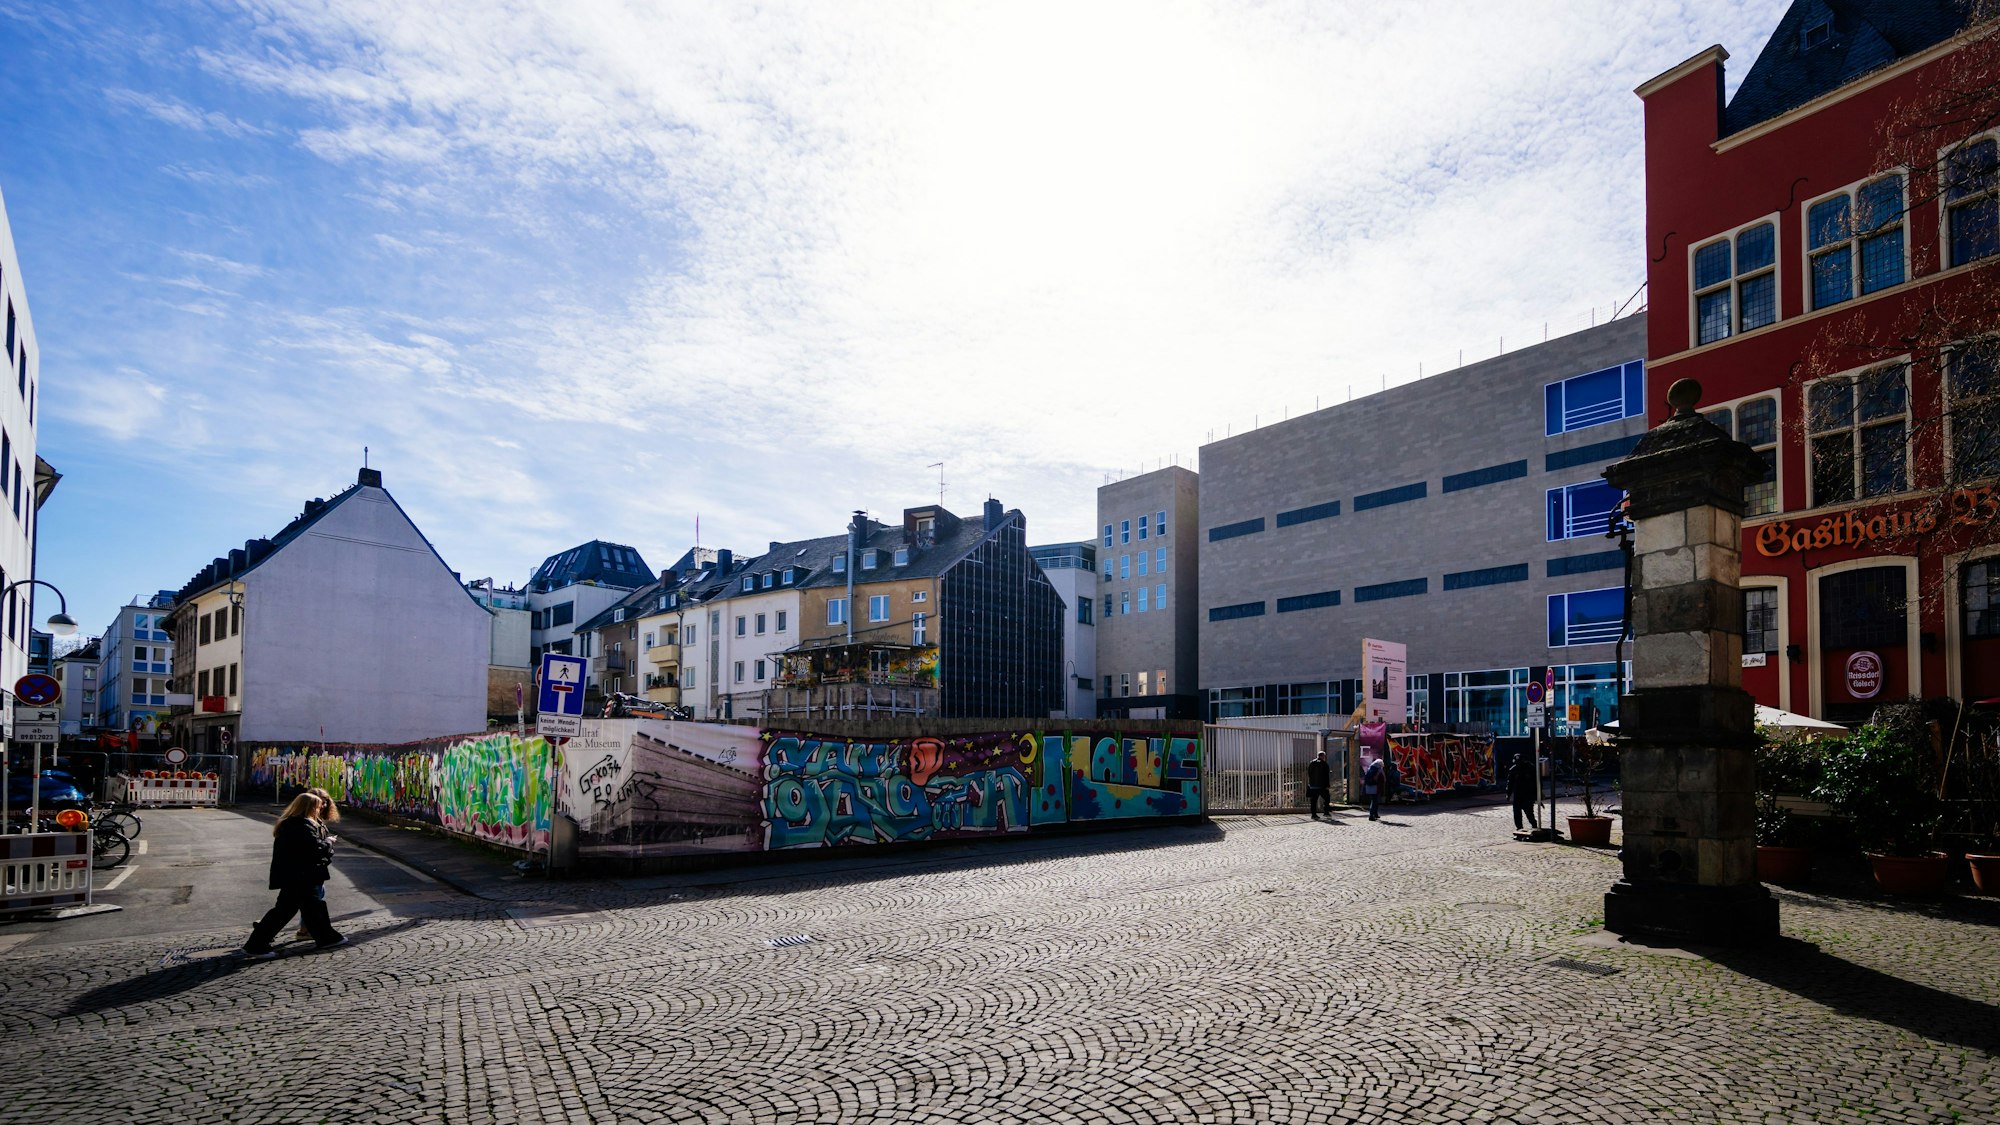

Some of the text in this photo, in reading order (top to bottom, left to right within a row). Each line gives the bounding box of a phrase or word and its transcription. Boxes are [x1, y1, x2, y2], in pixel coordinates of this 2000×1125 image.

[1755, 508, 1937, 557] Gasthaus
[557, 718, 579, 726] Wende-
[542, 726, 575, 734] möglichkeit
[581, 727, 600, 738] llraf
[568, 738, 621, 749] das Museum
